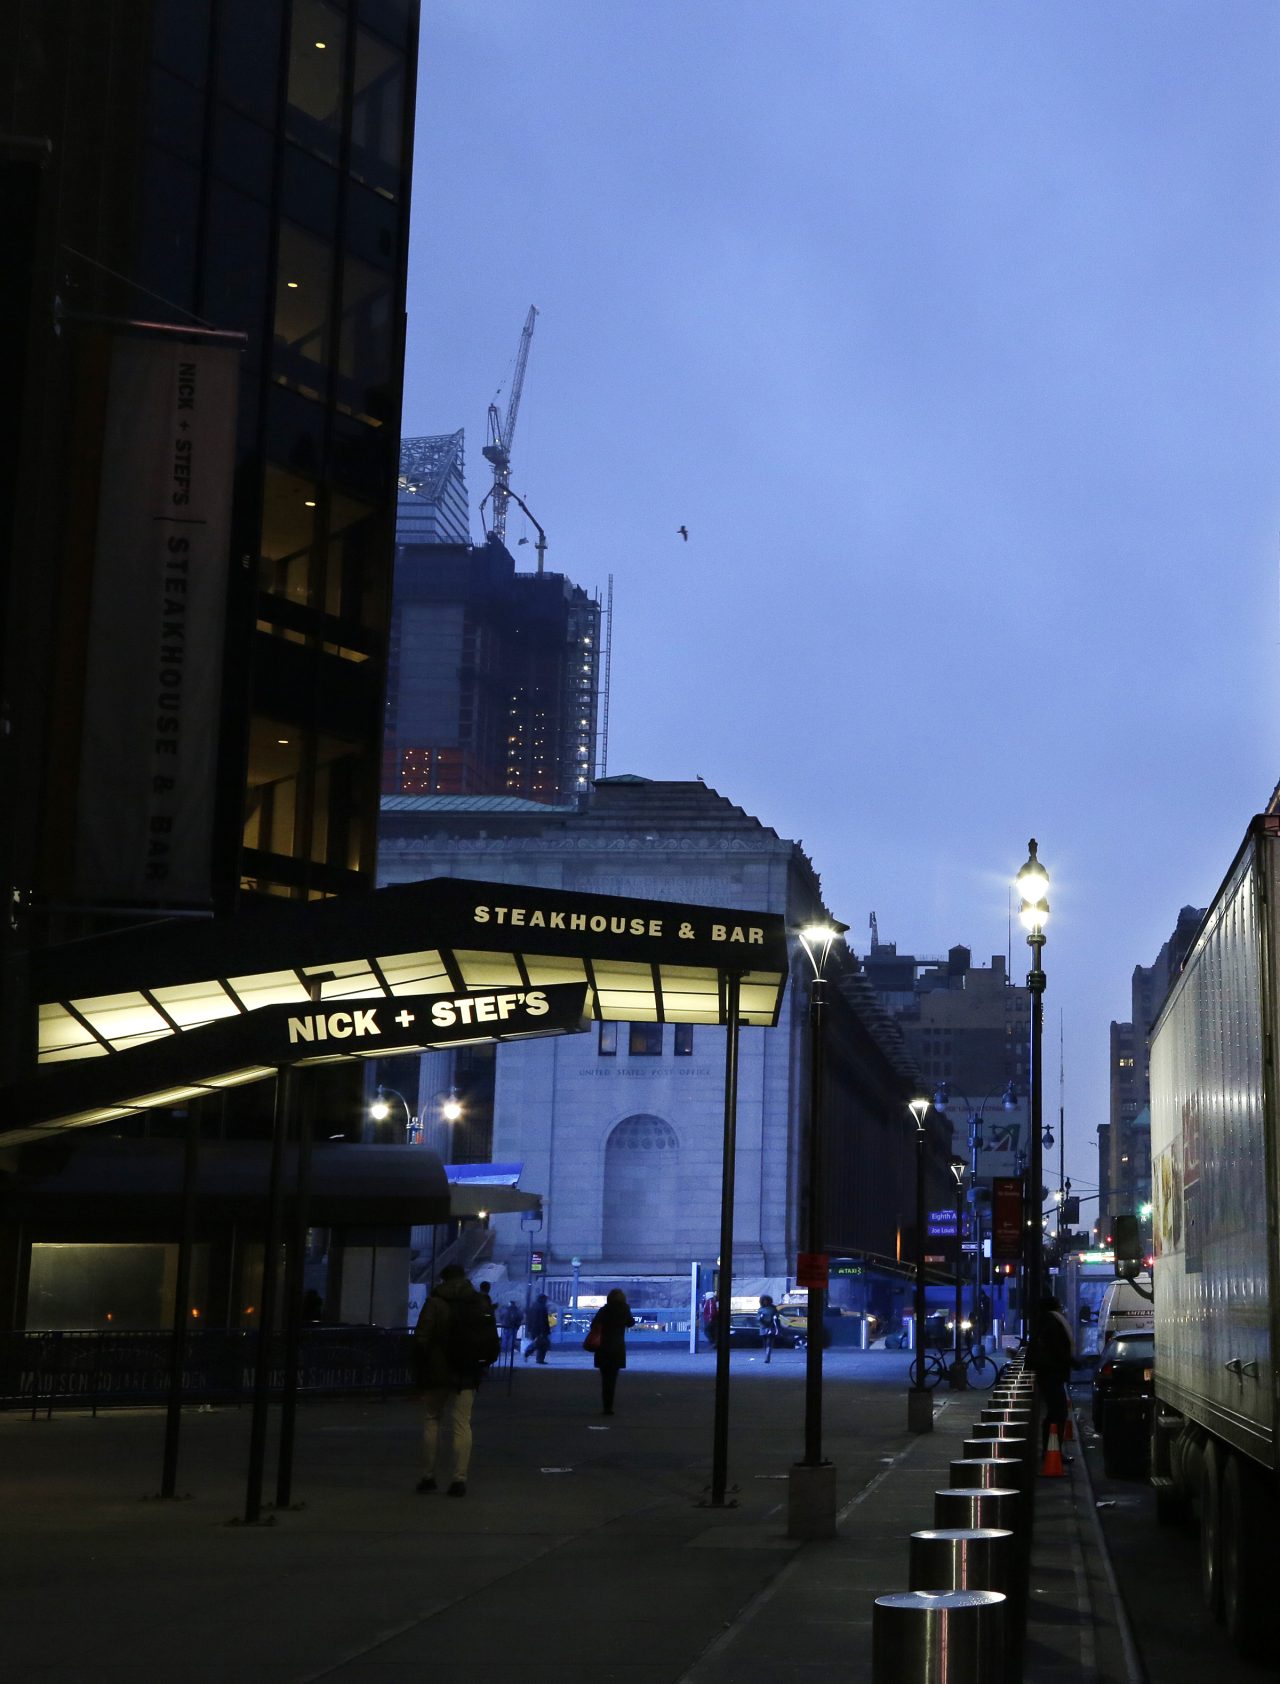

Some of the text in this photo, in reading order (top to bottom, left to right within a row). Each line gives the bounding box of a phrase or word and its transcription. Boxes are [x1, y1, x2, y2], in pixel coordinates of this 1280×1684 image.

[176, 362, 195, 410] NICK
[154, 536, 190, 757] STEAKHOUSE
[145, 816, 172, 881] BAR
[473, 905, 765, 945] STEAKHOUSE & BAR
[288, 1008, 381, 1043] NICK
[431, 991, 550, 1028] STEF'S
[931, 1212, 951, 1221] Eighth
[152, 1369, 207, 1389] GADEN
